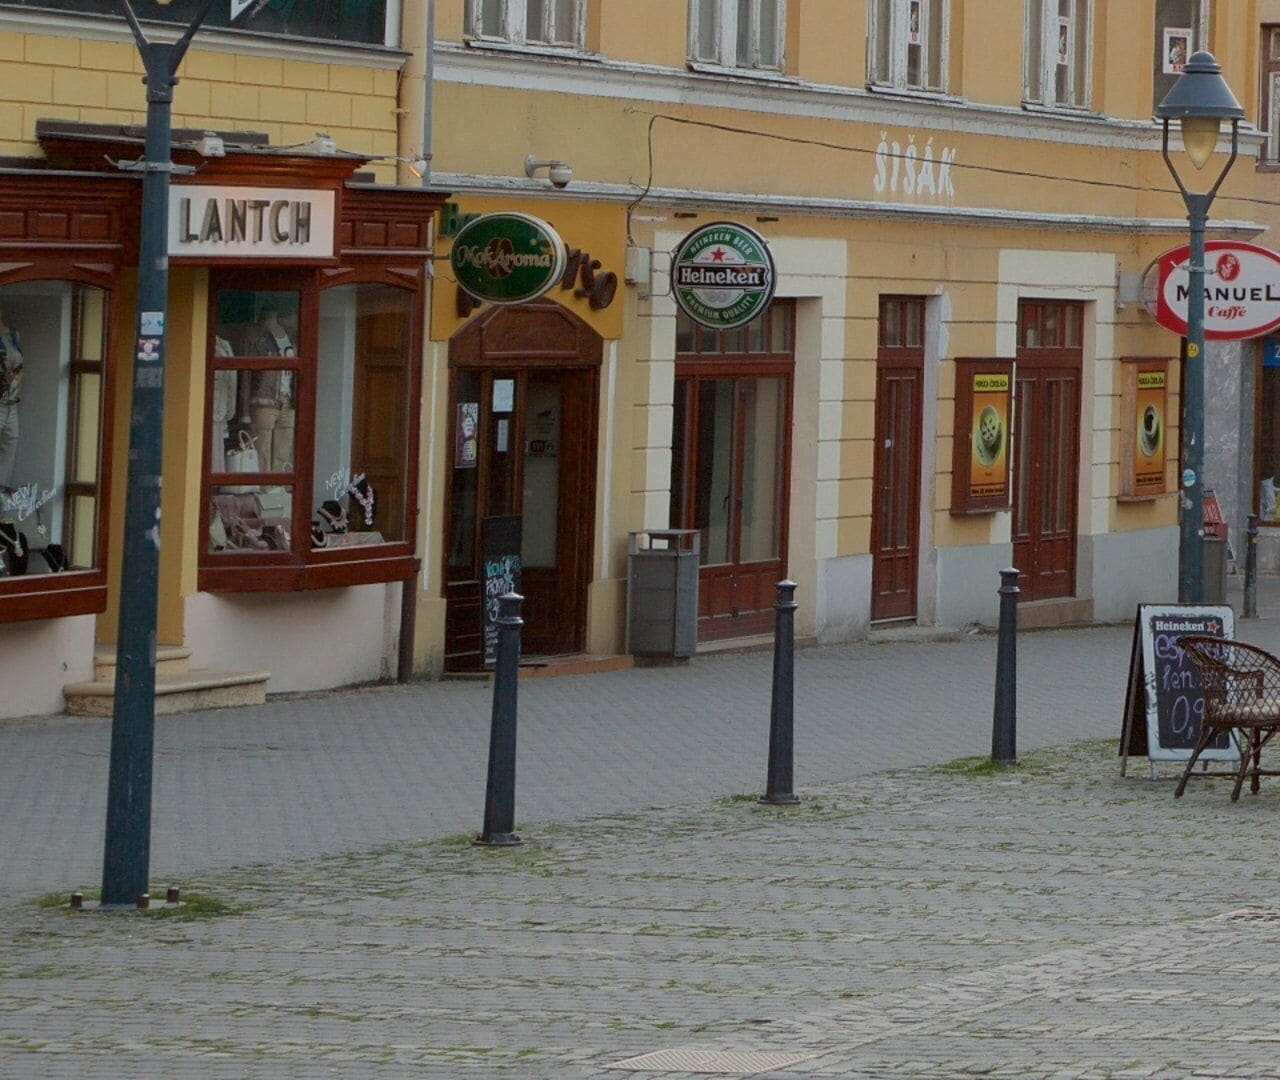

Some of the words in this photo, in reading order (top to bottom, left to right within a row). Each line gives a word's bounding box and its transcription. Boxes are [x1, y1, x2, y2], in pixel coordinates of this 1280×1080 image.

[179, 197, 312, 244] LANTCH
[689, 232, 732, 255] HEINEKEN
[732, 236, 754, 256] BEER
[680, 267, 761, 286] Heineken
[686, 294, 720, 319] PREMIUM
[722, 295, 755, 320] QUALITY
[1155, 620, 1205, 632] Heineken
